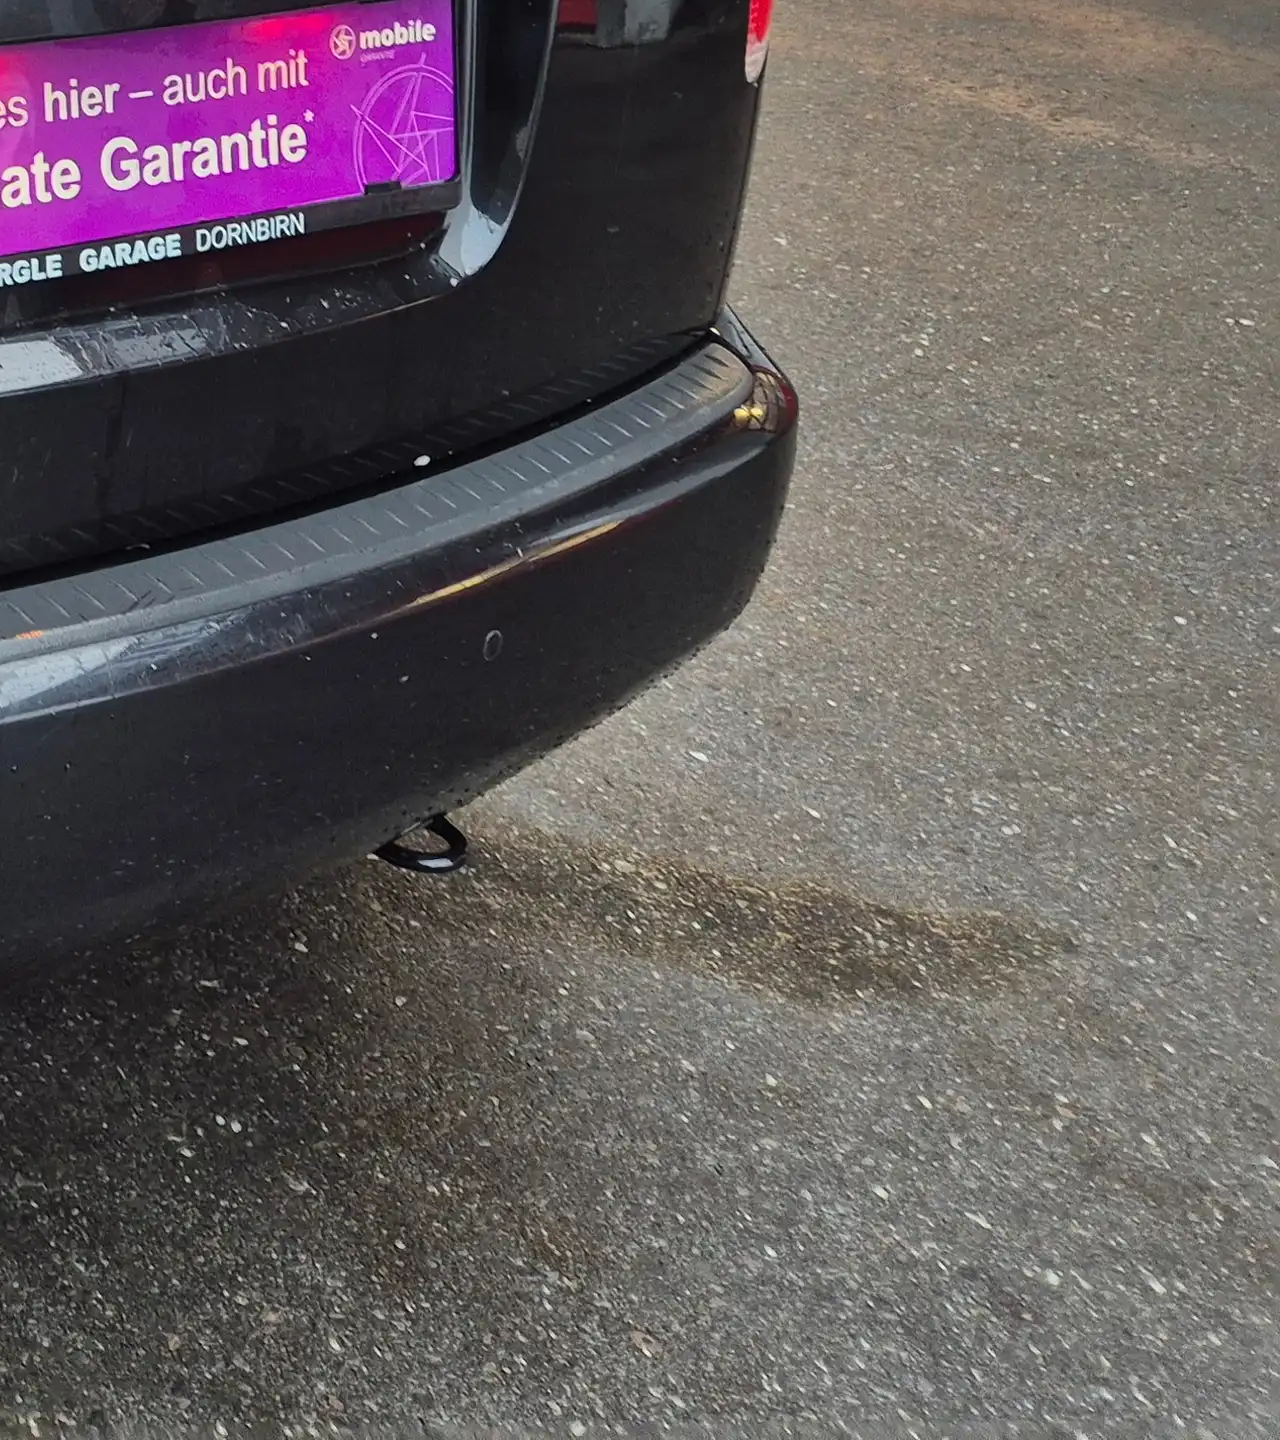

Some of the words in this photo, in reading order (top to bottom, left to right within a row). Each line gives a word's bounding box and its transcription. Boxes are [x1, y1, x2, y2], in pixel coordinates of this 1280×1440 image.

[360, 19, 436, 49] mobile
[43, 78, 121, 122] hier
[163, 58, 247, 105] auch
[257, 49, 309, 92] mit
[79, 234, 182, 272] GARAGE
[196, 212, 306, 252] DORNBIRN
